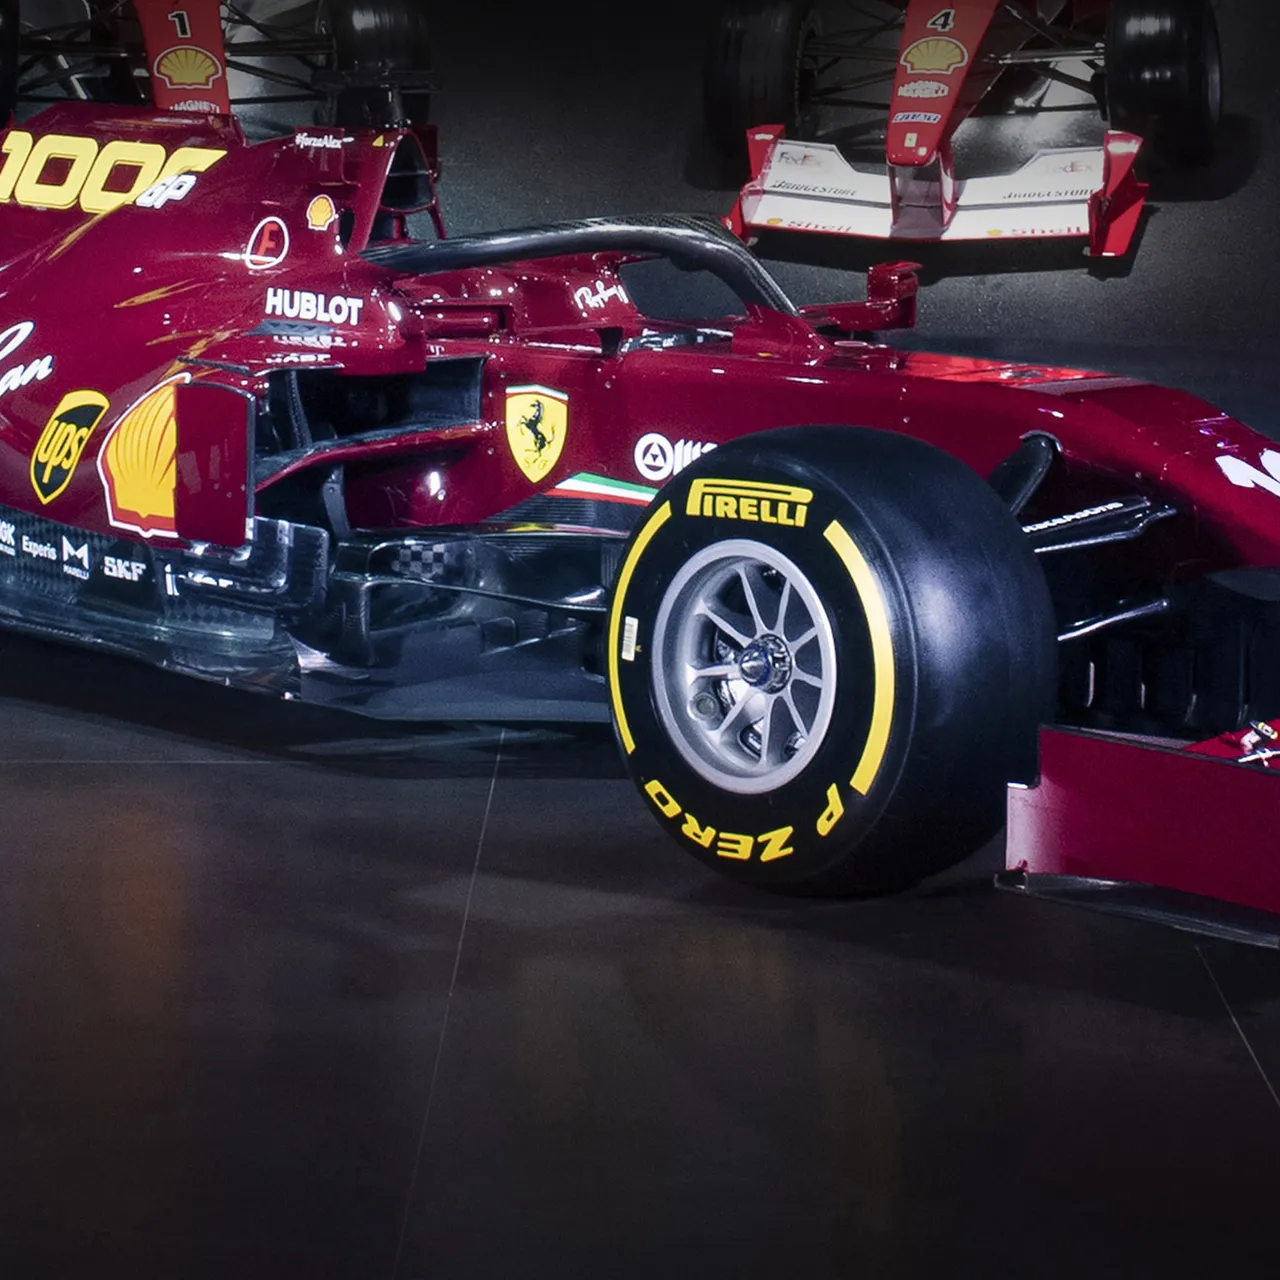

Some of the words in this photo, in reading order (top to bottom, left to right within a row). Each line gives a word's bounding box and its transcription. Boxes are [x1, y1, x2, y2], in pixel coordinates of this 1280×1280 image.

[168, 11, 192, 38] 1
[926, 8, 956, 32] 4
[265, 287, 363, 325] HUBLOT
[685, 477, 814, 528] PIRELLI
[22, 535, 57, 561] Experis
[103, 555, 147, 582] SKF
[644, 779, 795, 863] ZERO
[816, 782, 845, 837] P
